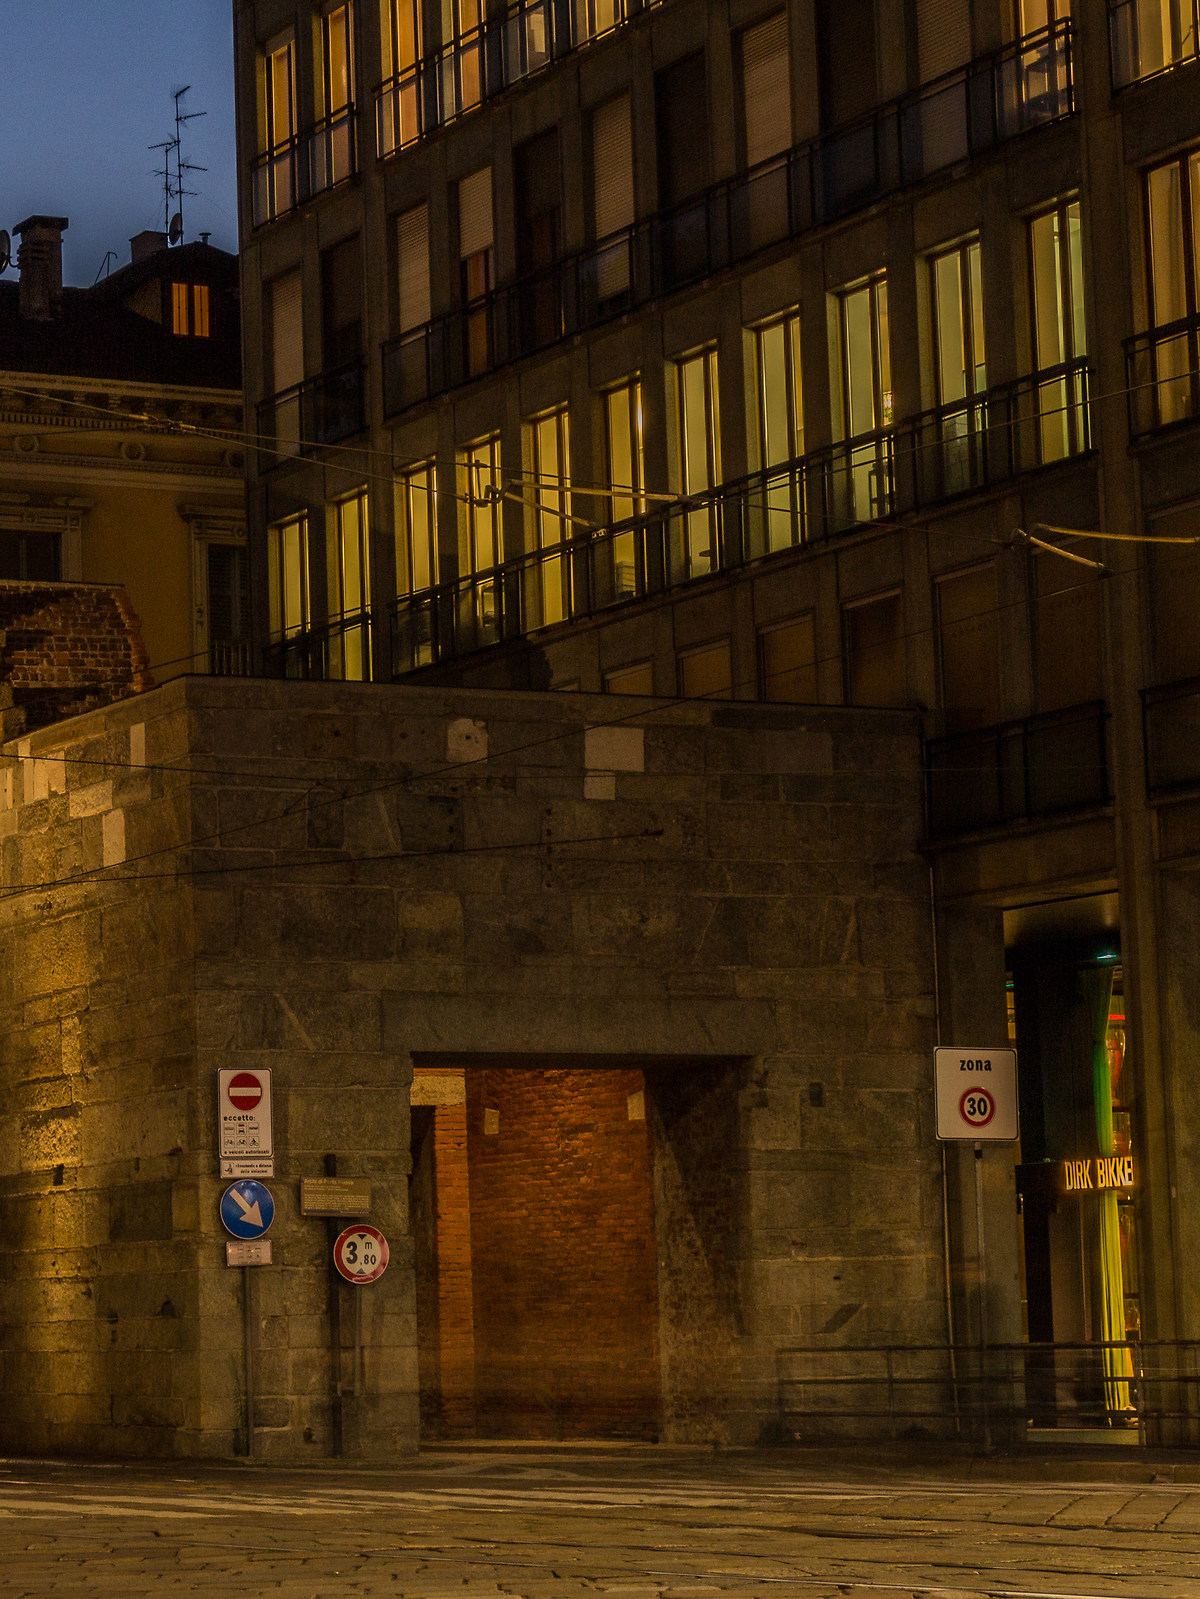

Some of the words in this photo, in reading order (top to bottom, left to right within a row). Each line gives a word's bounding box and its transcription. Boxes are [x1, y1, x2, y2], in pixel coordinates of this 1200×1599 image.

[959, 1059, 992, 1071] zona
[967, 1097, 988, 1116] 30
[1064, 1159, 1094, 1190] DIRK
[1096, 1156, 1134, 1188] BIKKE
